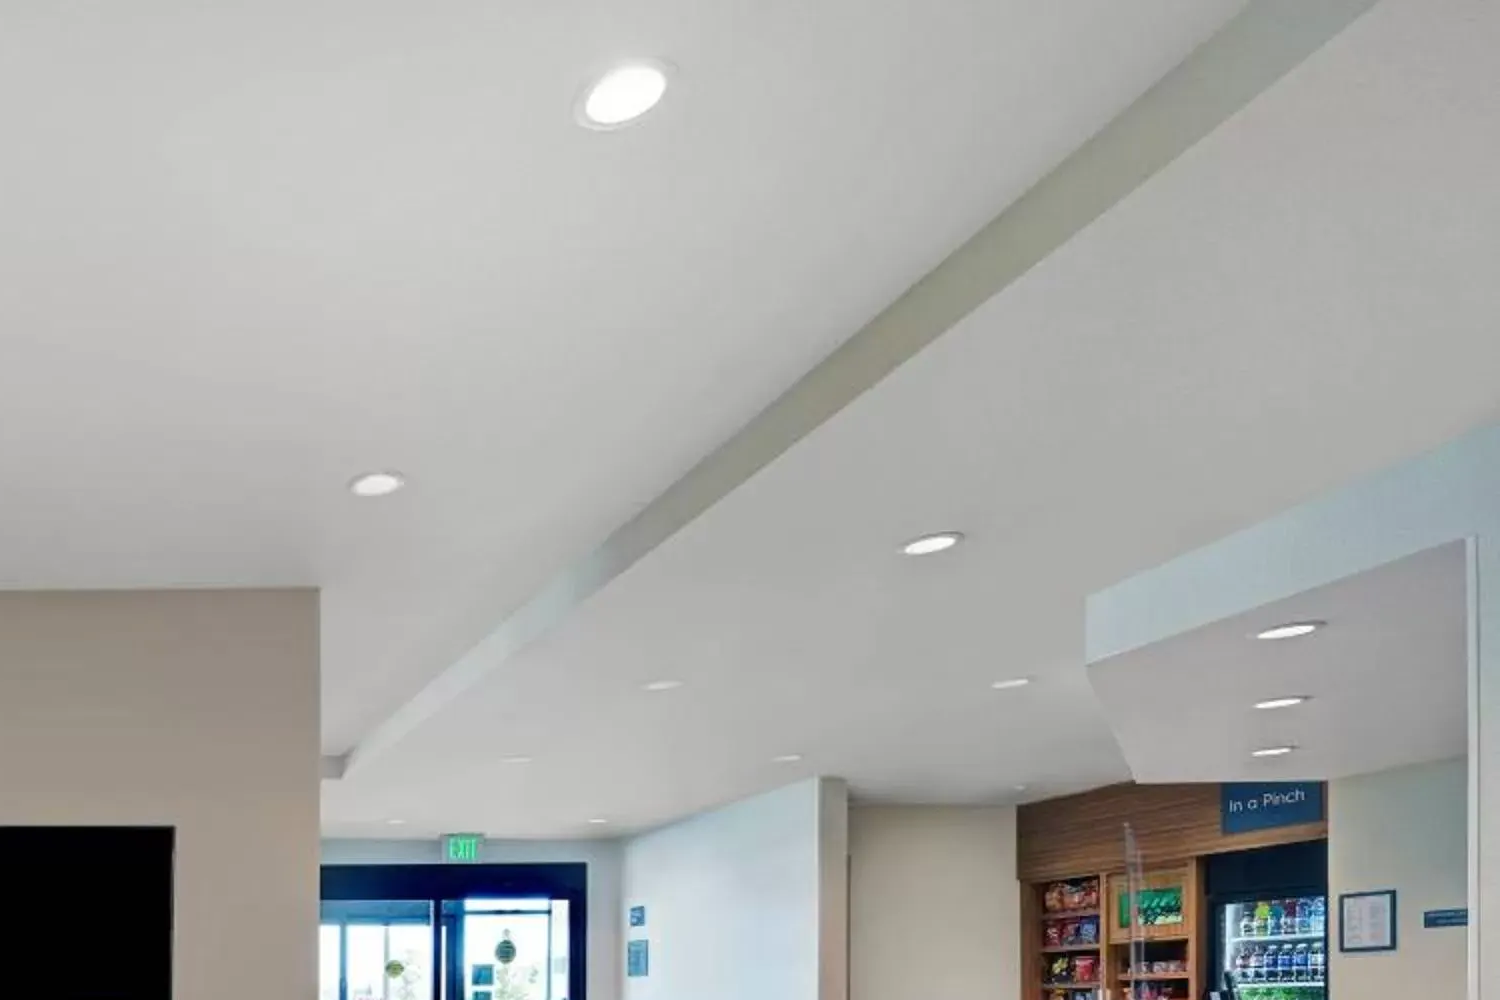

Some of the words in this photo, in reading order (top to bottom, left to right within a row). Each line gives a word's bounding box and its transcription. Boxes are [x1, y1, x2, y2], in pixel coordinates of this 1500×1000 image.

[1229, 799, 1243, 813] In
[1247, 799, 1257, 810] a
[1263, 789, 1305, 808] Pinch
[449, 838, 477, 859] EXIT
